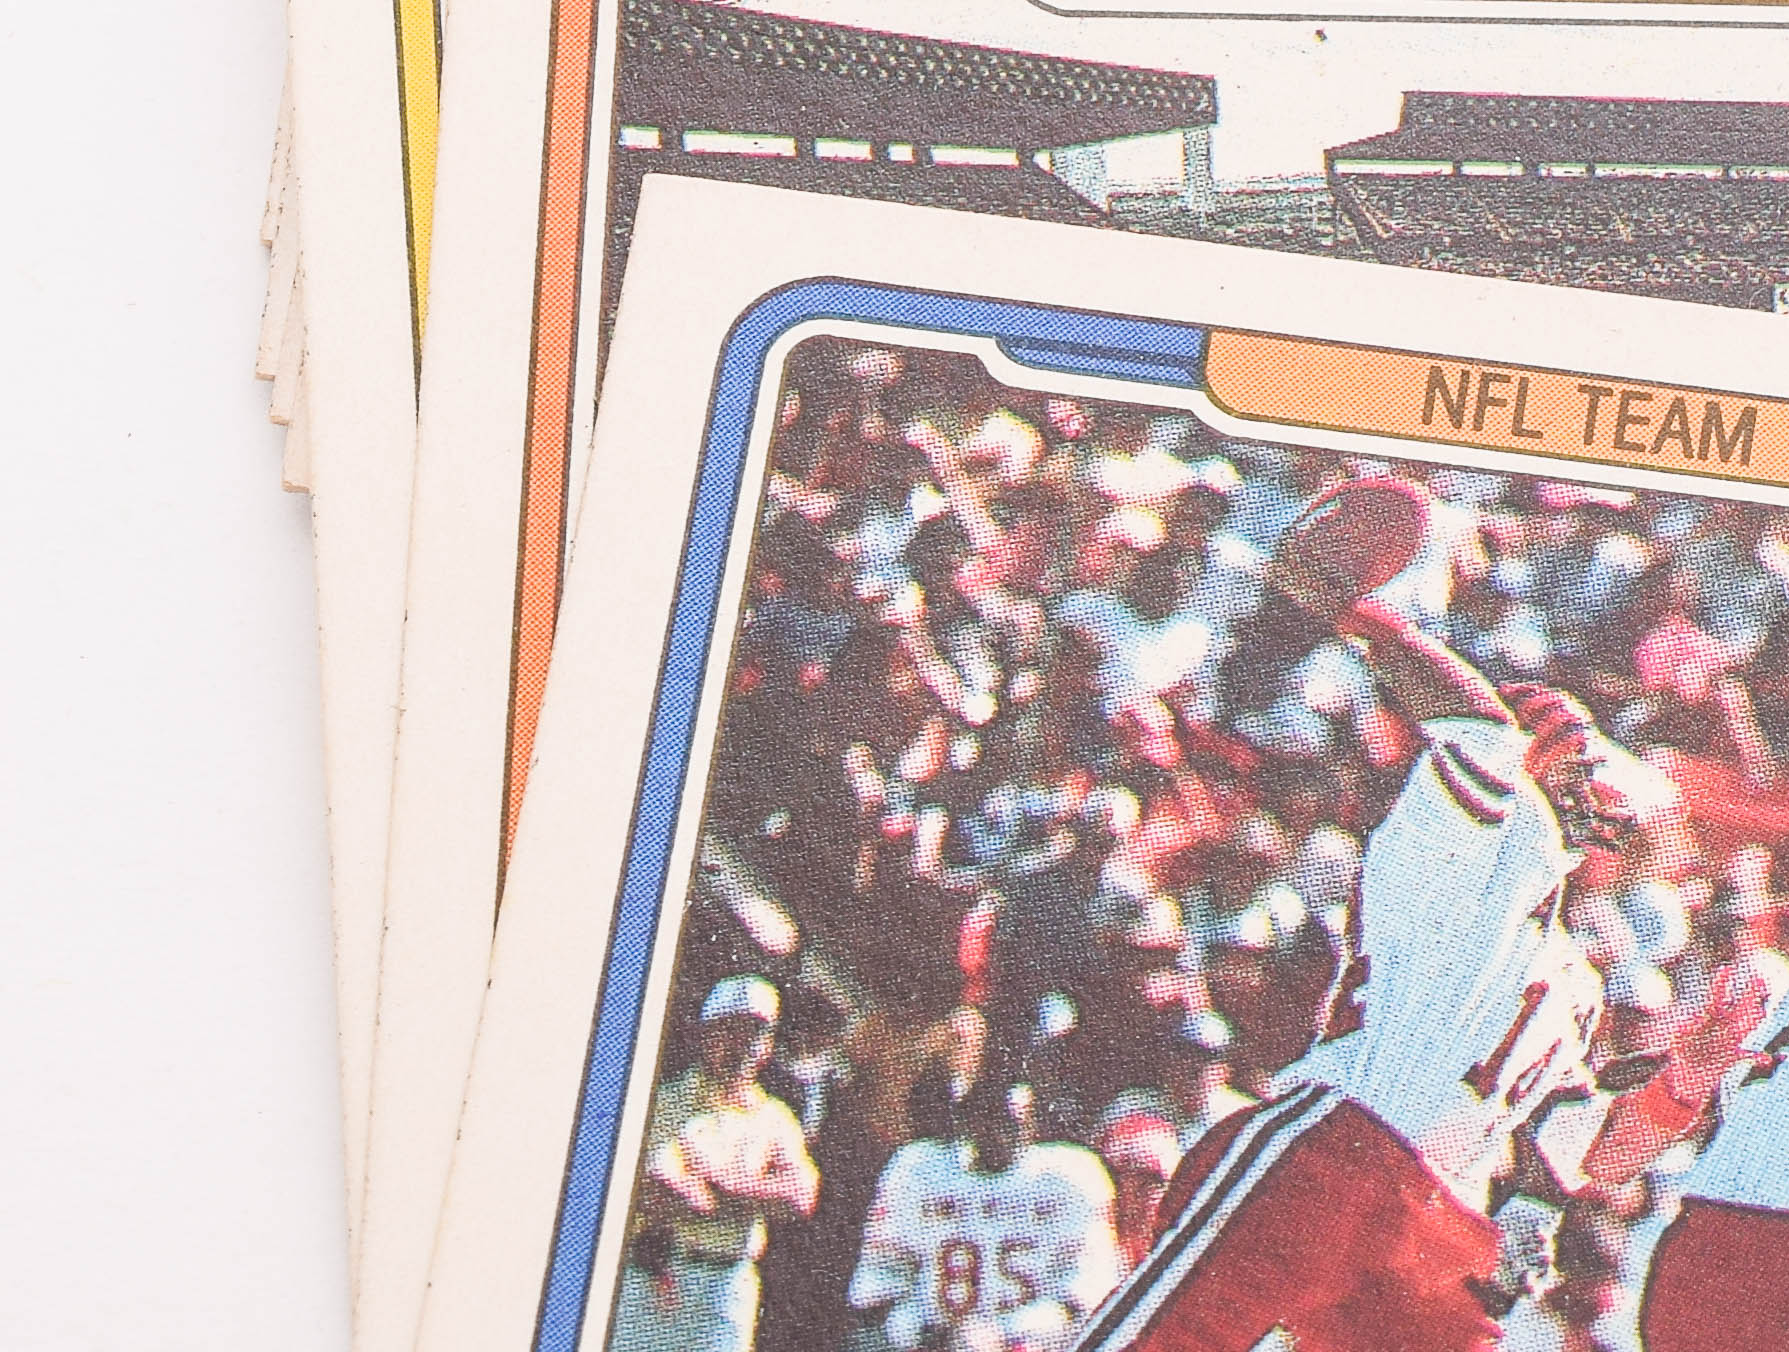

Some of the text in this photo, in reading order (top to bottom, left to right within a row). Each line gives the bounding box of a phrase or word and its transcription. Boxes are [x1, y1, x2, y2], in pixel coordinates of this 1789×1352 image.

[1421, 365, 1544, 439] NFL
[1578, 384, 1758, 467] TEAM
[936, 1235, 1038, 1325] 85
